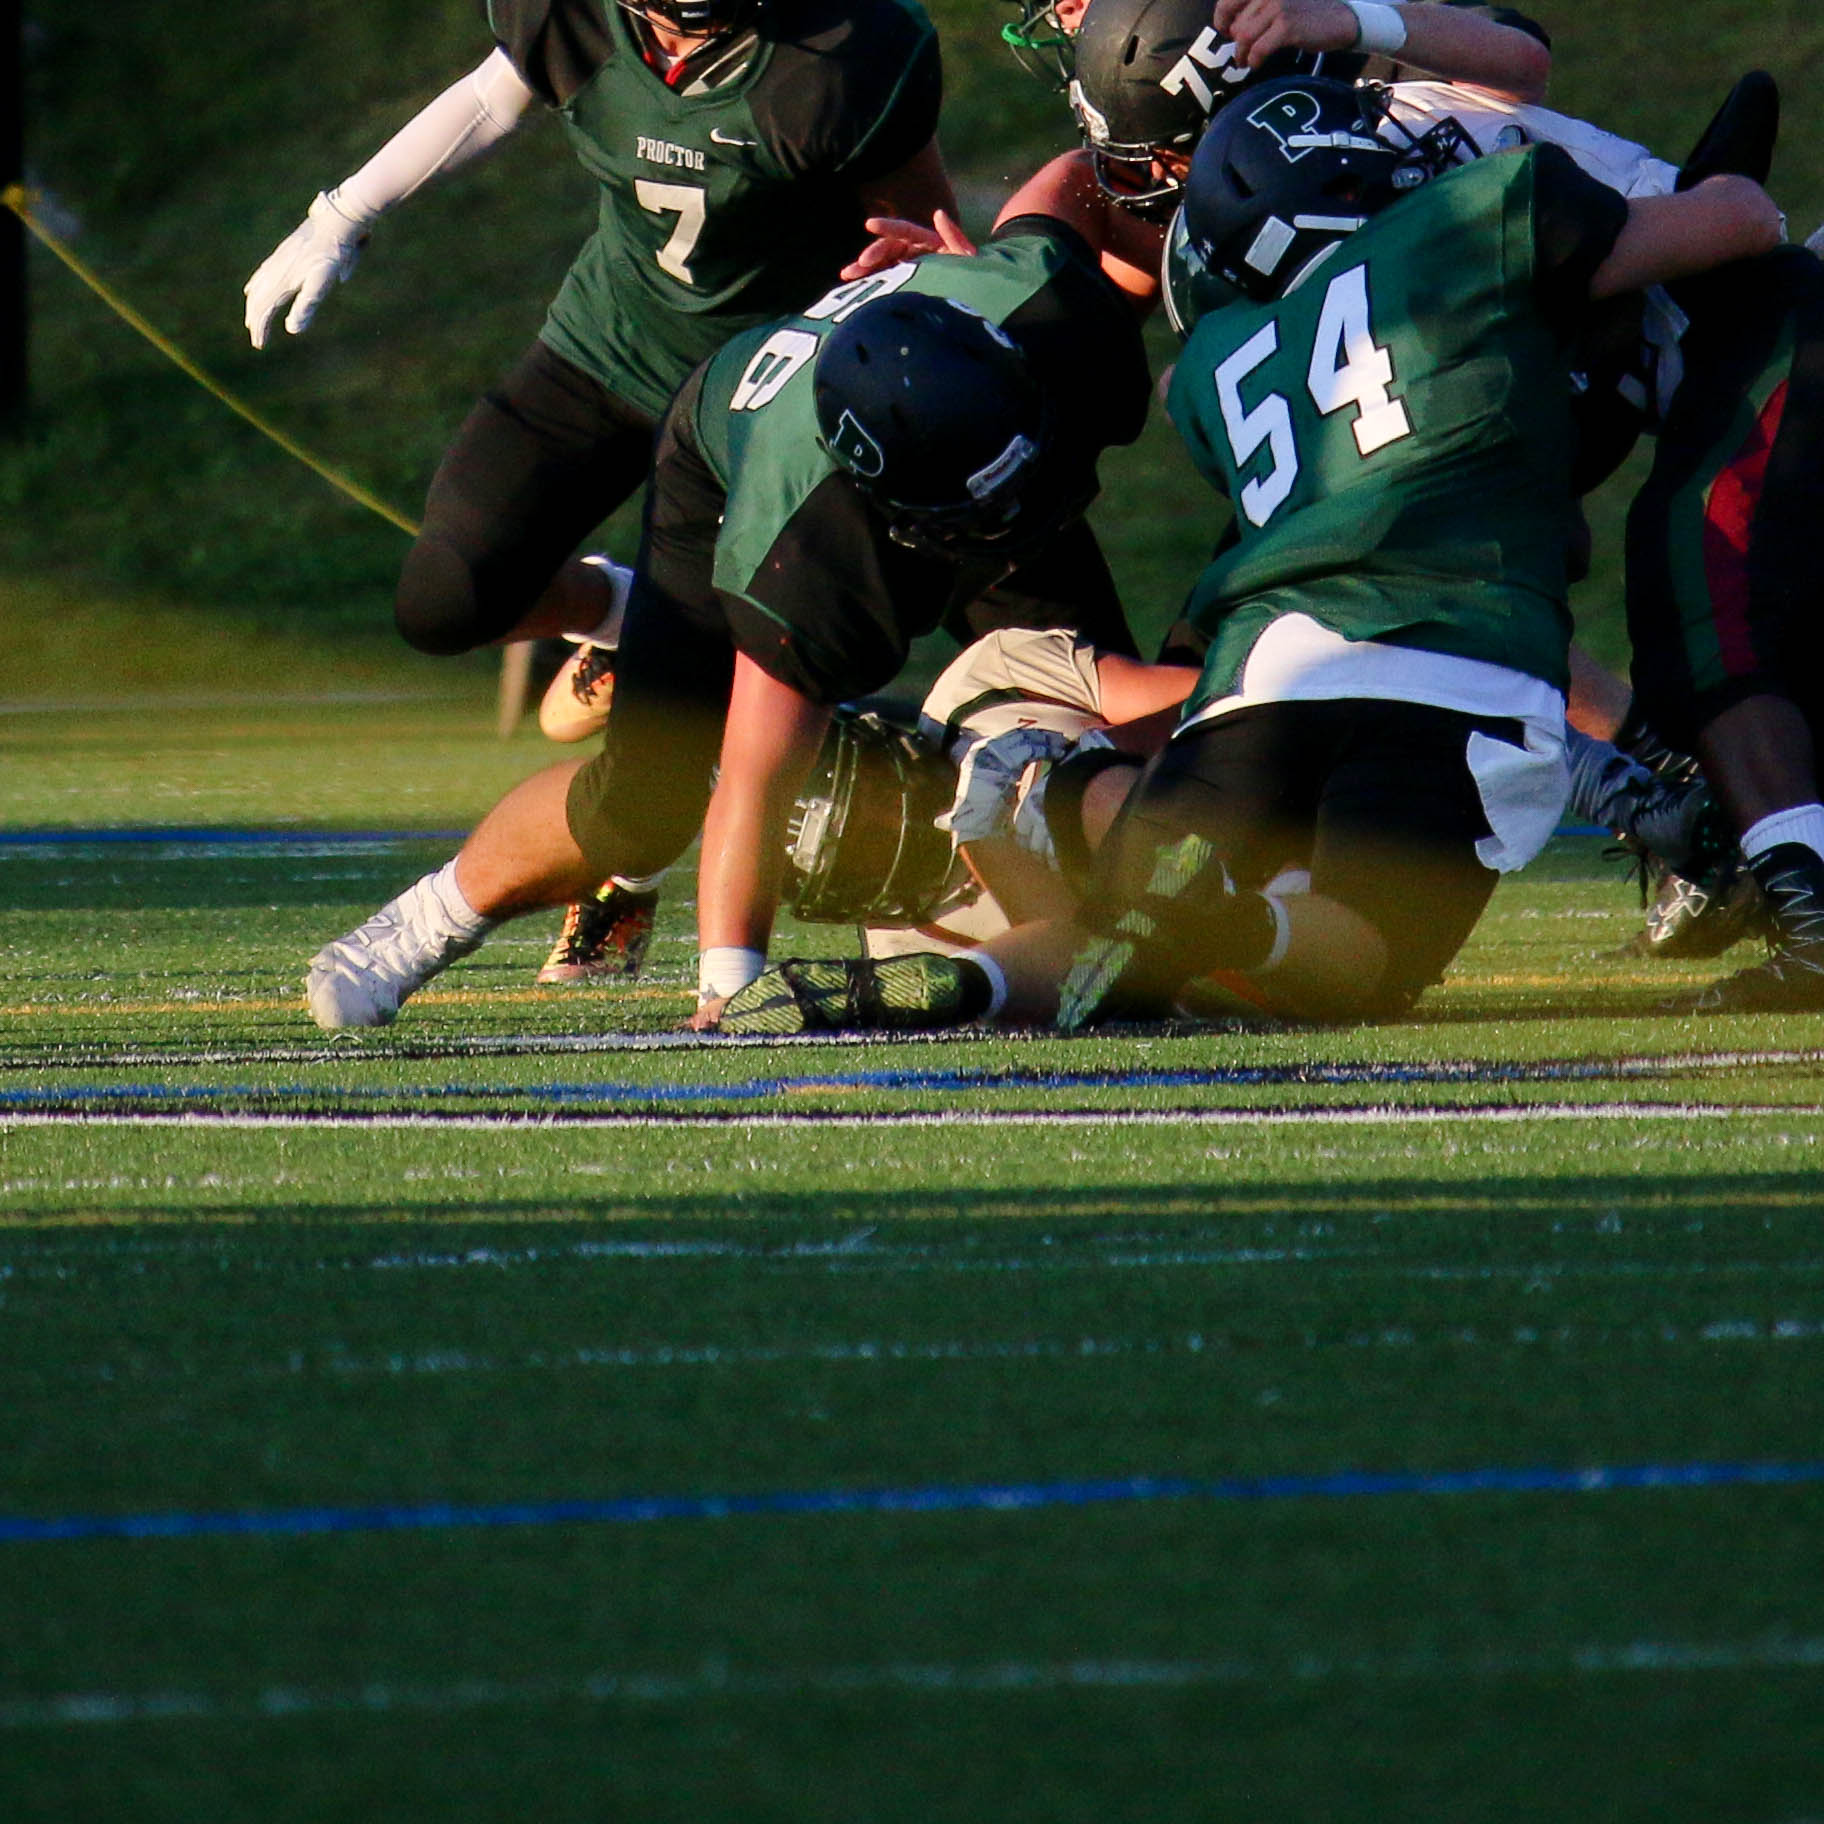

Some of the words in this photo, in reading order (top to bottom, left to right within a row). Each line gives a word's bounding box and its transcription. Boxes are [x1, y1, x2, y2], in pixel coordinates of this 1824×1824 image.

[1159, 25, 1252, 115] 75
[636, 135, 706, 172] PROCTOR
[633, 178, 707, 286] 7
[1213, 262, 1412, 530] 54
